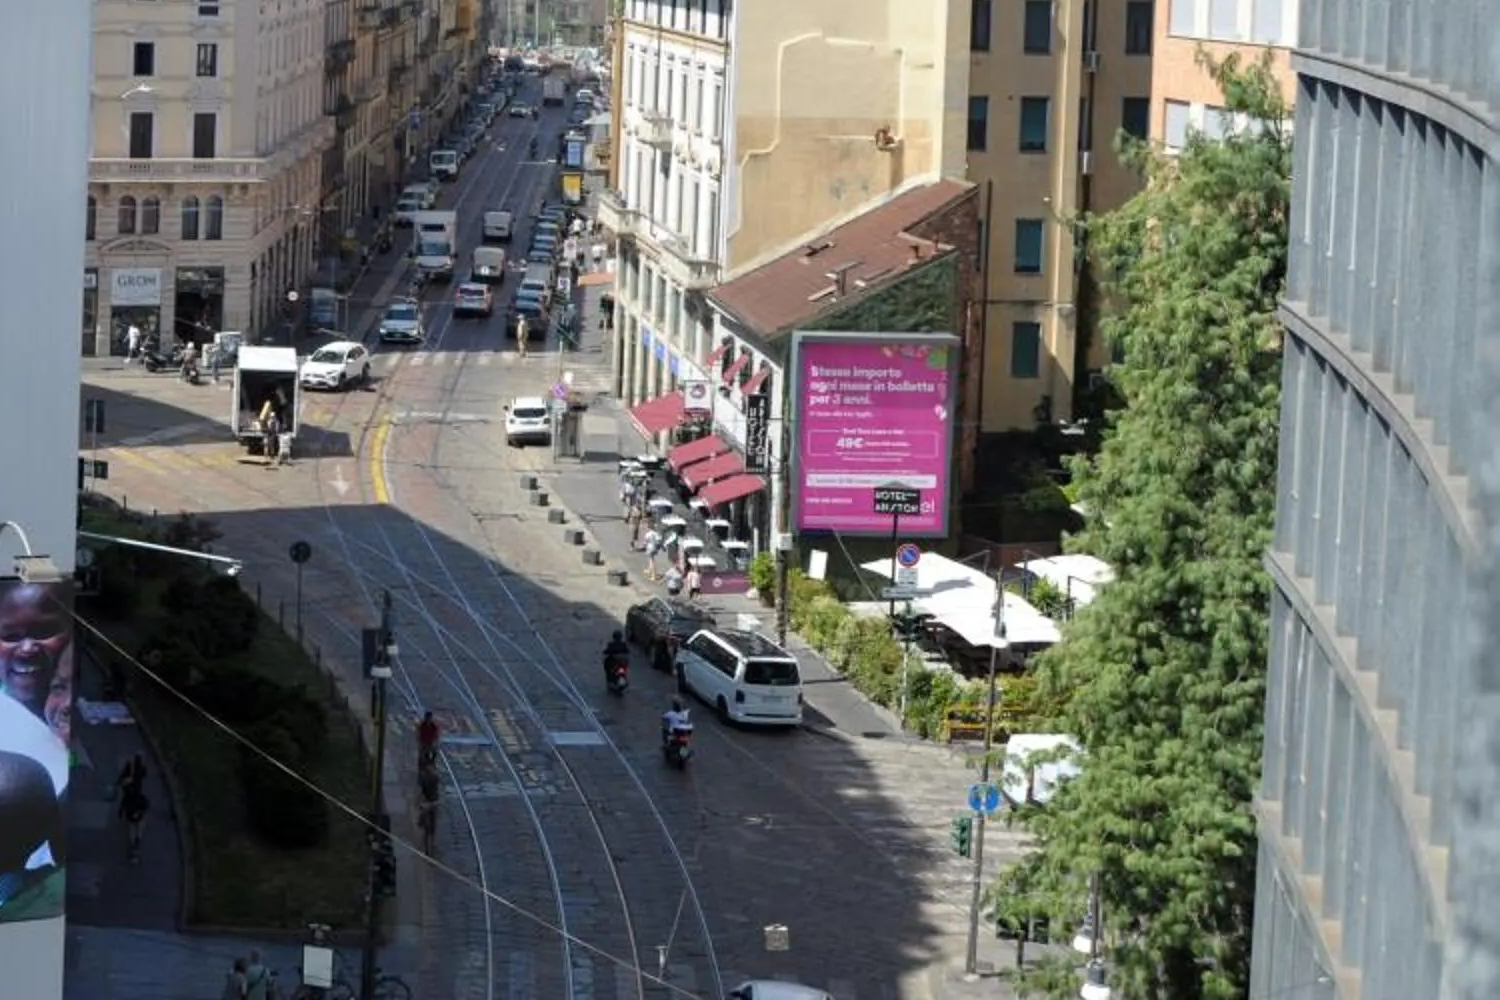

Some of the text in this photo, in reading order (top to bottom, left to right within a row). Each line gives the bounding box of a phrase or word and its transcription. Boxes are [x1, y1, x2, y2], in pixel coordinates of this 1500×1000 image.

[853, 365, 902, 379] importo
[874, 380, 885, 391] in
[887, 380, 934, 392] bolletta
[809, 395, 829, 406] per
[875, 491, 906, 500] HOTEL
